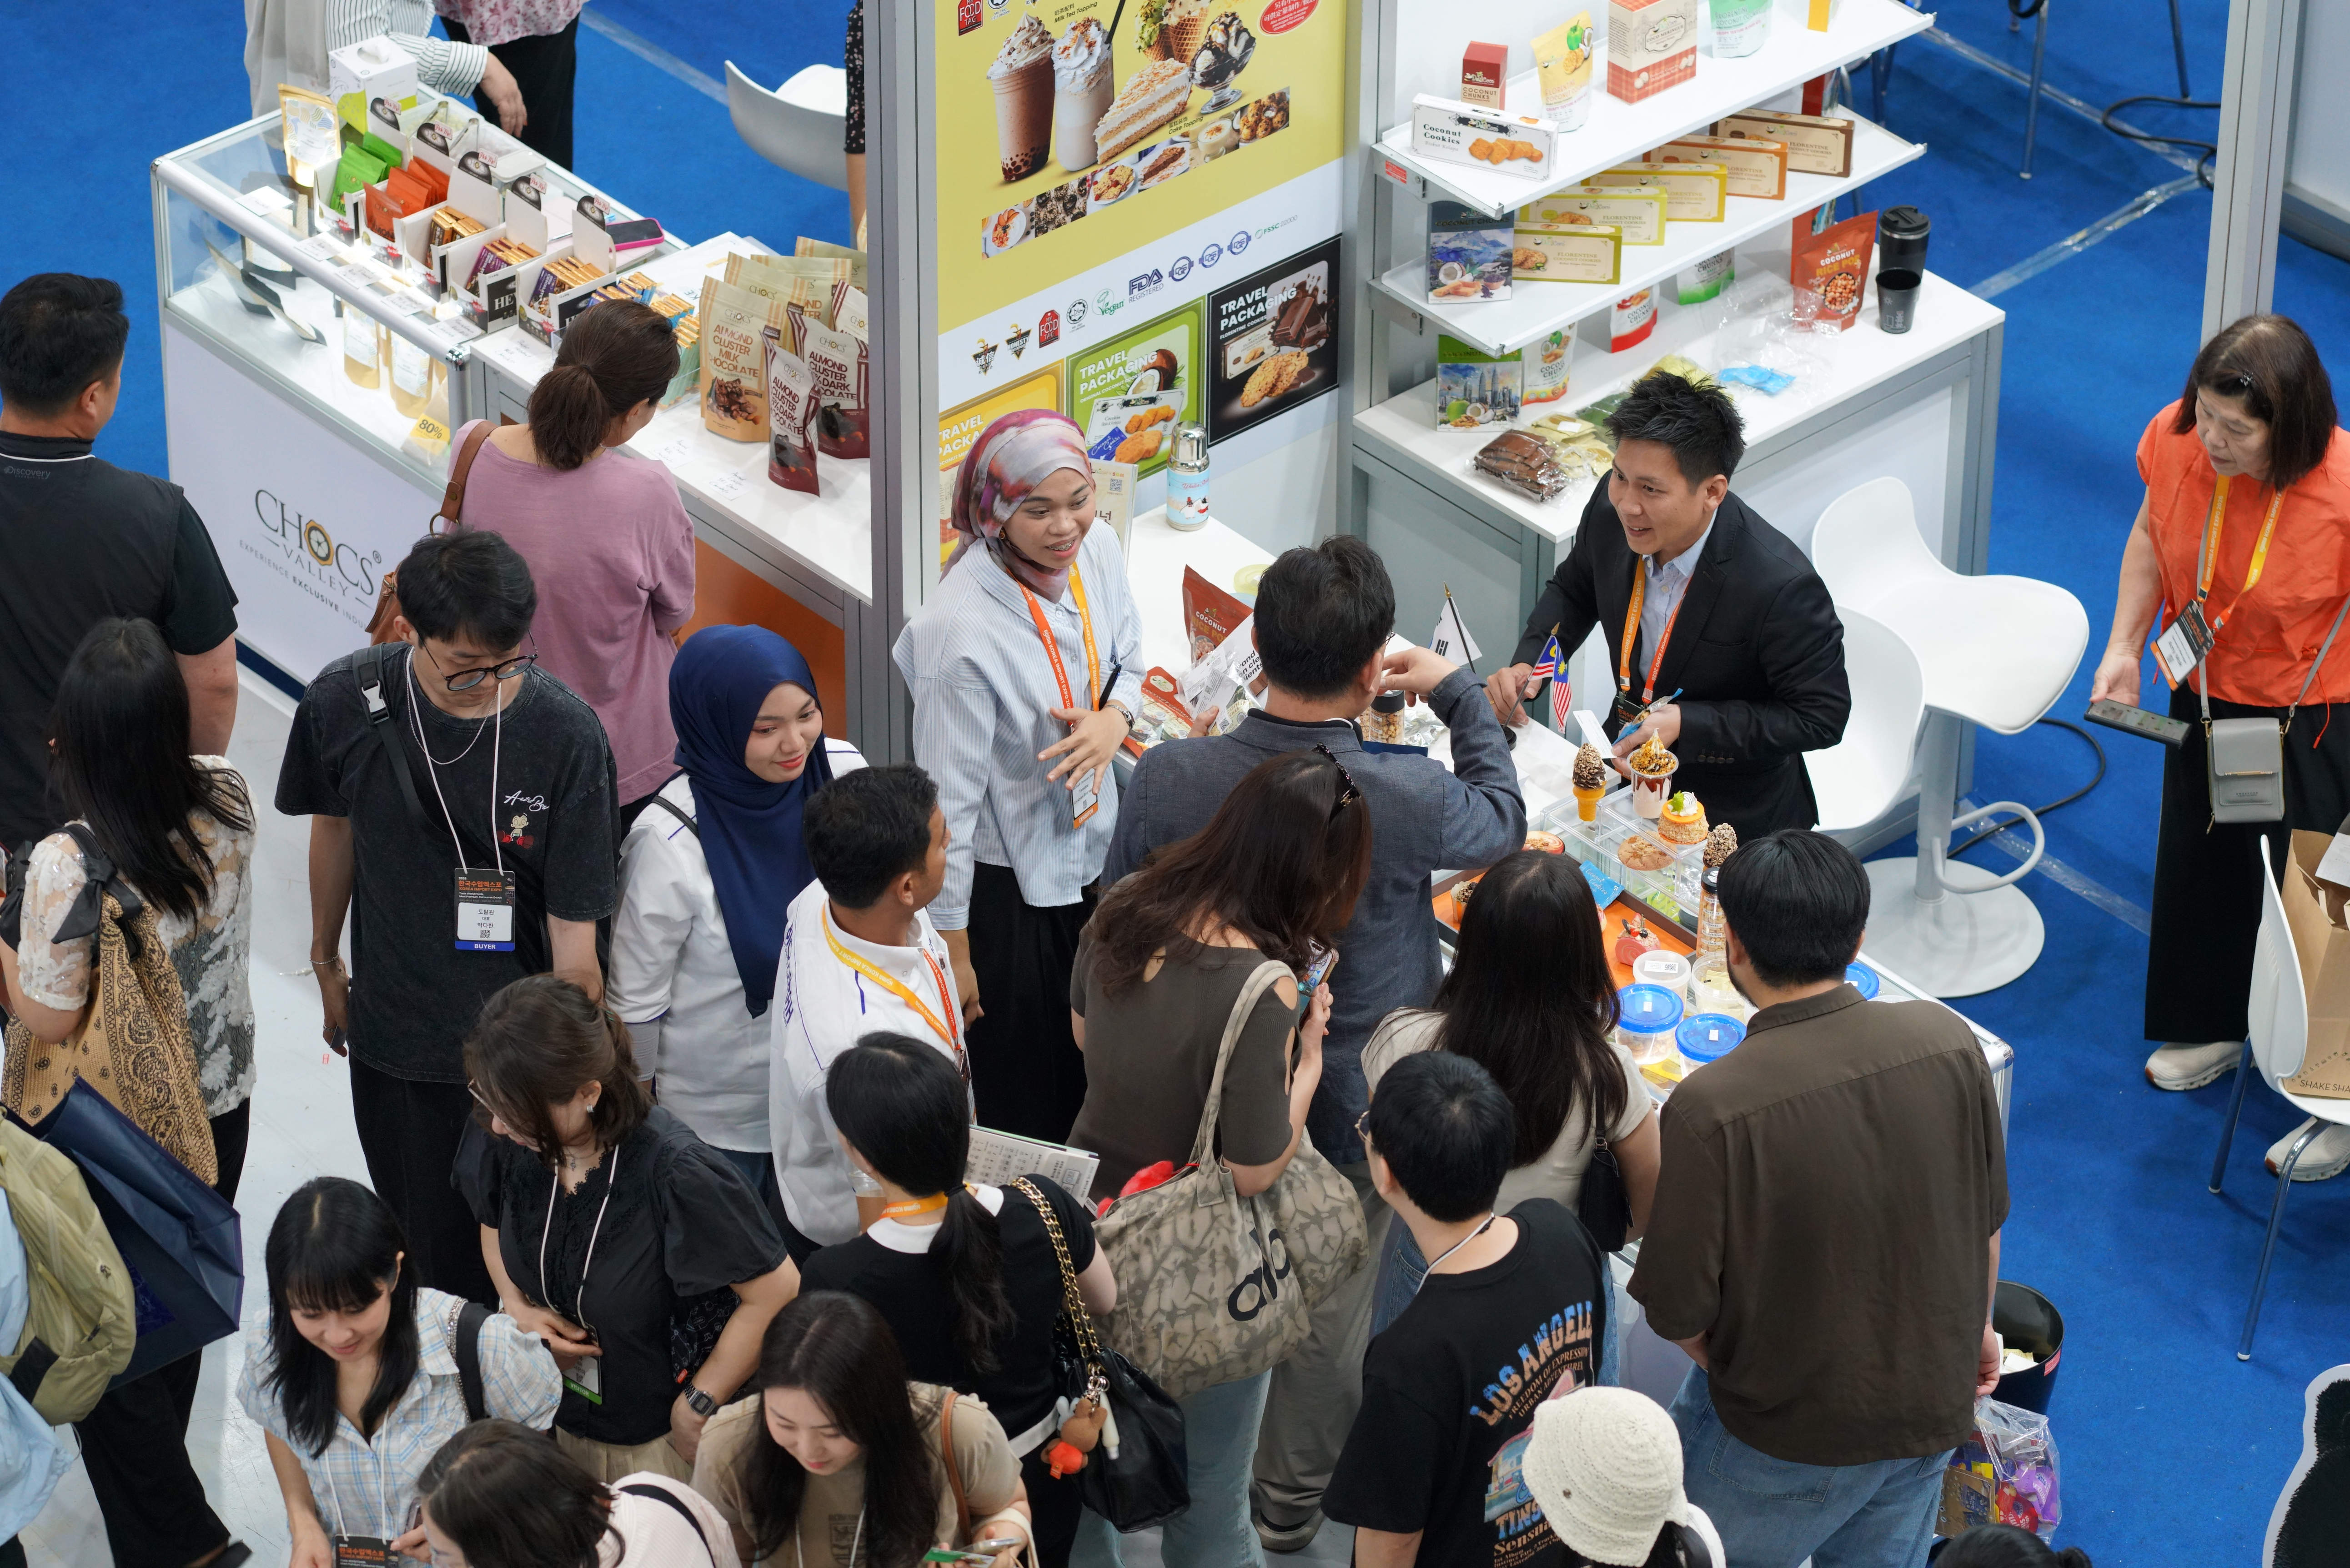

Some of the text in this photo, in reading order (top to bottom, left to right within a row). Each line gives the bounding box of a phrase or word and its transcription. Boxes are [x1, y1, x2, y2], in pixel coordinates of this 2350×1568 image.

[959, 1, 982, 21] FOOD
[1054, 2, 1098, 23] Milk Tea Topping
[1463, 87, 1497, 95] COCONUT
[1169, 116, 1203, 134] Cake Topping
[1423, 124, 1462, 137] Coconut
[1424, 132, 1460, 145] Cookies
[1790, 141, 1828, 151] FLORENTINE
[1264, 215, 1298, 234] FSSC 22000
[1435, 219, 1475, 227] COCONUT
[1816, 254, 1860, 276] RICE POP
[1820, 249, 1855, 266] COCONUT
[749, 285, 777, 301] CHOCS
[1129, 269, 1163, 296] FDA
[1129, 283, 1164, 303] REGISTERED
[1220, 286, 1268, 315] TRAVEL
[1220, 287, 1297, 331] PACKAGING
[724, 308, 753, 324] CHOCS
[713, 324, 753, 346] ALMOND
[1040, 319, 1059, 337] FOOD
[1220, 315, 1267, 340] FLORENTINE COOKIES
[713, 335, 751, 356] CLUSTER
[819, 336, 847, 353] CHOCS
[1007, 336, 1029, 351] HONESTY
[719, 348, 740, 363] MILK
[809, 351, 848, 372] ALMOND
[976, 351, 995, 365] 诚信
[1080, 350, 1128, 379] TRAVEL
[809, 361, 847, 382] CLUSTER
[1080, 351, 1158, 395] PACKAGING
[773, 376, 799, 404] ALMOND
[822, 378, 851, 392] DARK
[1080, 390, 1102, 403] ORIGINAL
[1102, 380, 1125, 394] COCONUT
[772, 386, 796, 413] CLUSTER
[779, 404, 797, 426] DARK
[418, 418, 442, 439] 80%
[8, 466, 51, 479] Discovery
[2264, 519, 2273, 538] KOREA
[255, 489, 374, 596] CHOCS
[239, 539, 289, 579] EXPERIENCE
[292, 575, 340, 613] EXCLUSIVE
[281, 544, 349, 597] VALLEY
[2250, 568, 2259, 586] 2026
[1191, 615, 1210, 635] RICE
[1195, 611, 1227, 633] COCONUT
[1627, 614, 1637, 638] IMPORT
[1632, 595, 1640, 616] EXPO
[1085, 624, 1093, 643] EXPO
[1087, 642, 1095, 665] IMPORT
[1655, 650, 1664, 667] EXPO
[1049, 642, 1068, 700] KOREA IMPORT EXPO
[1652, 663, 1660, 681] 2026
[504, 790, 550, 812] Astro Boy
[1079, 808, 1094, 824] EXHIBITOR
[1585, 868, 1604, 882] Coconut
[1588, 879, 1608, 896] Cookies
[829, 938, 881, 978] KOREA IMPORT EXPO
[925, 954, 939, 973] KOREA
[935, 971, 946, 996] IMPORT
[944, 995, 952, 1010] EXPO
[570, 1382, 589, 1397] VISITOR
[1508, 1346, 1590, 1420] FREEDOM OF EXPRESSION
[1469, 1364, 1525, 1426] LOS
[1518, 1391, 1542, 1417] URBAN
